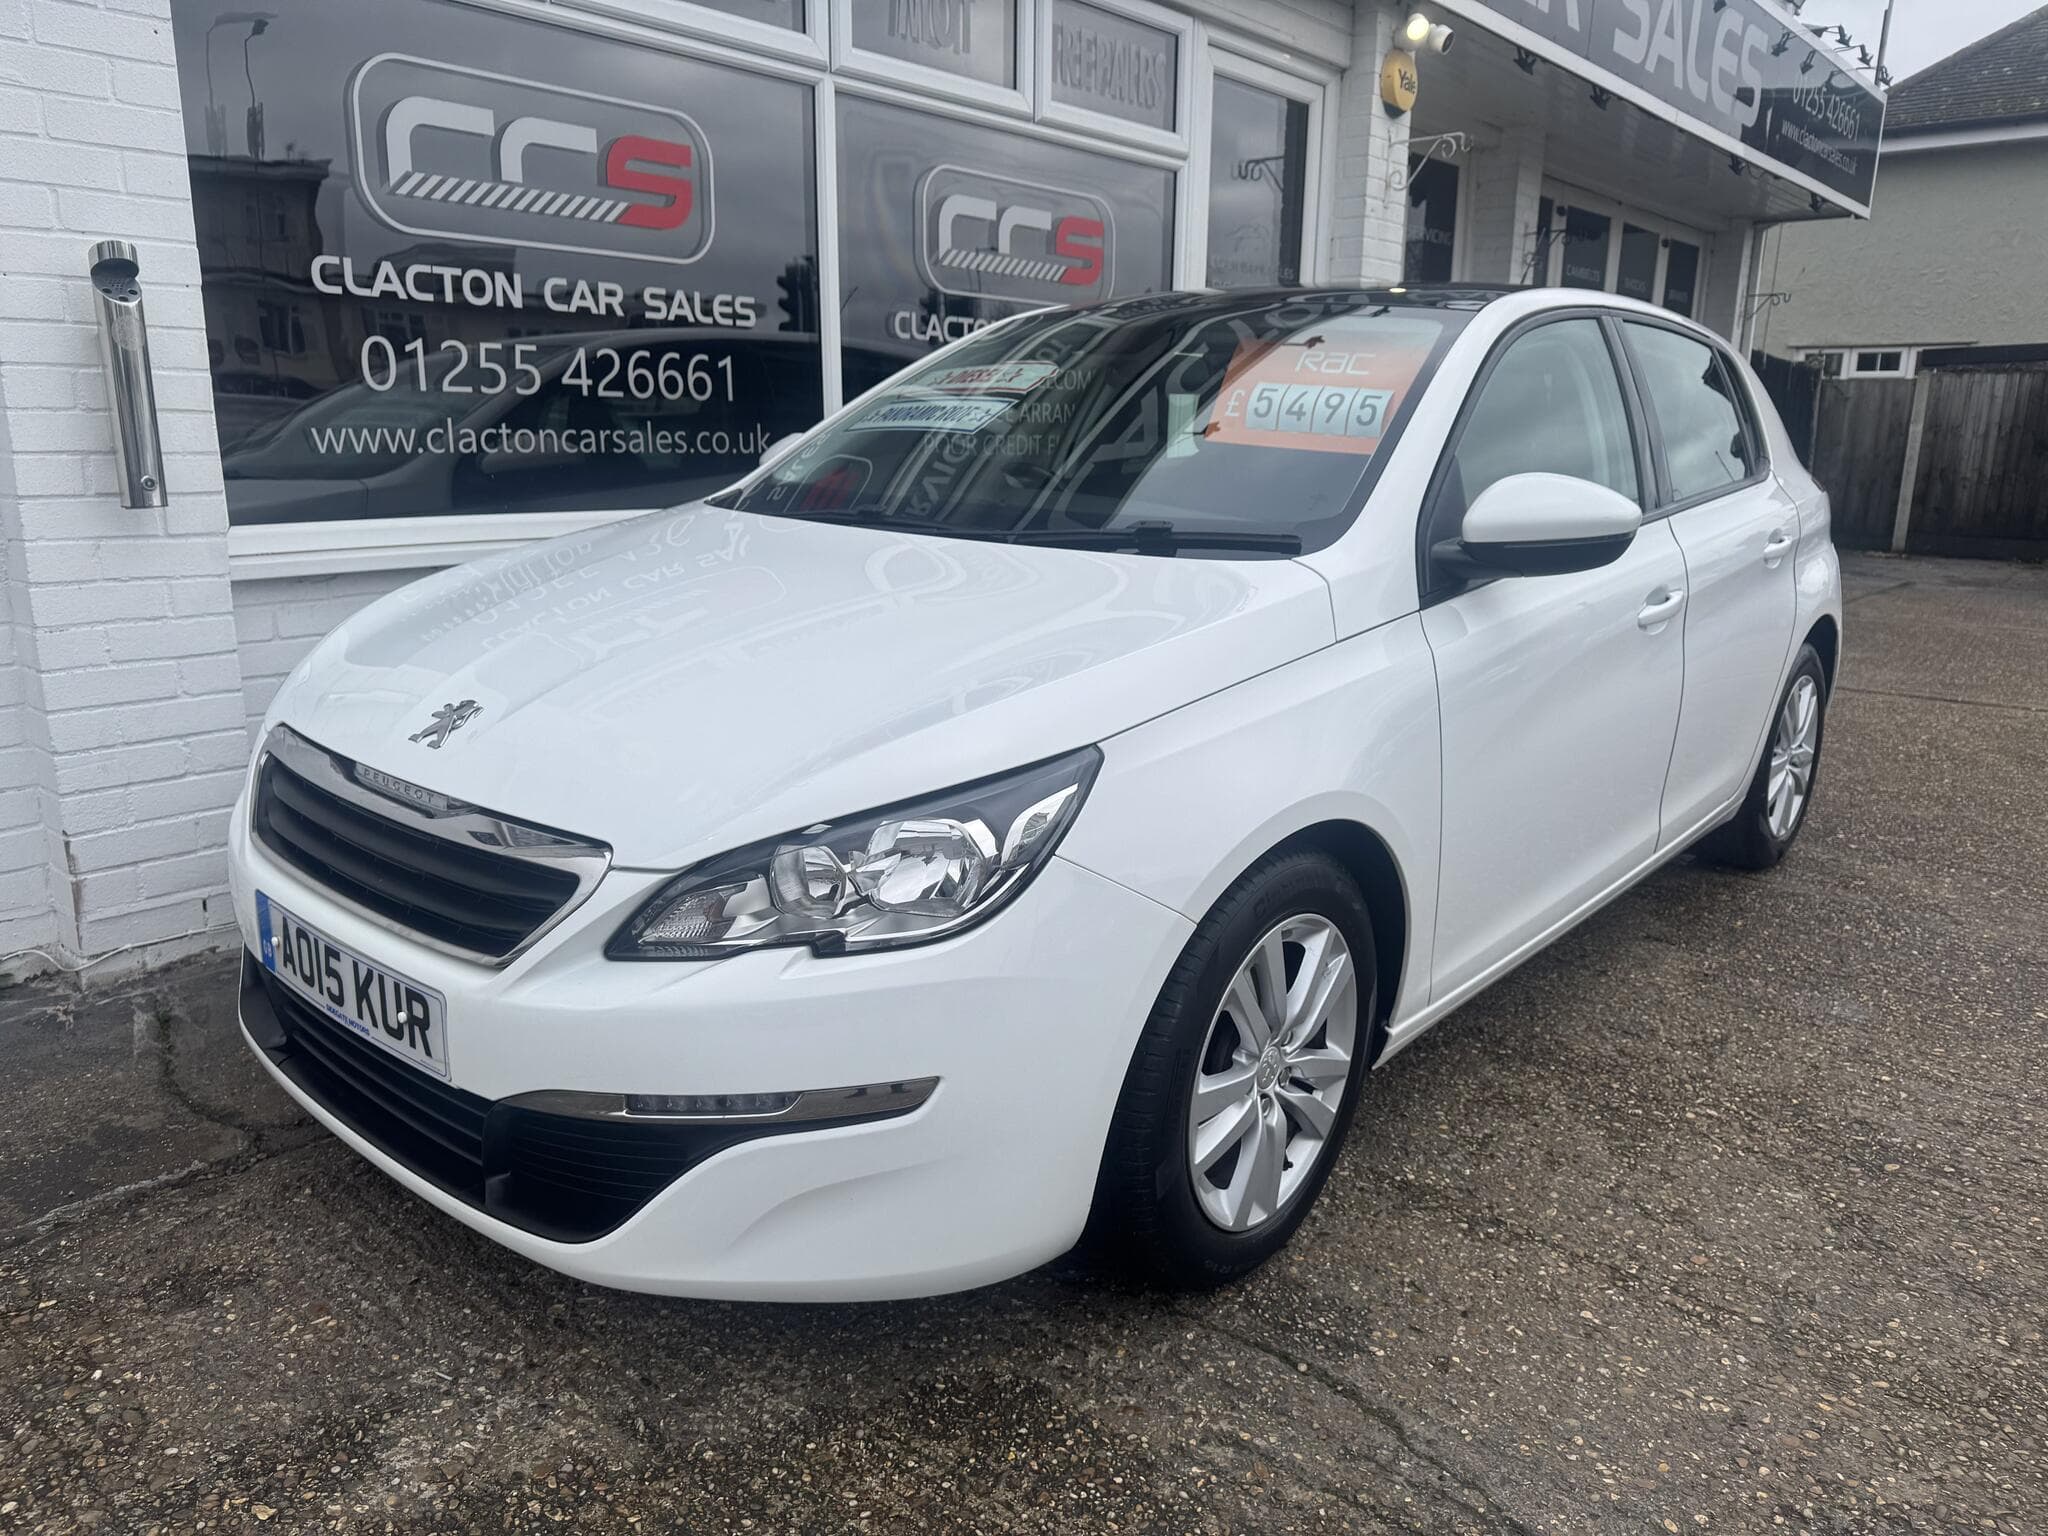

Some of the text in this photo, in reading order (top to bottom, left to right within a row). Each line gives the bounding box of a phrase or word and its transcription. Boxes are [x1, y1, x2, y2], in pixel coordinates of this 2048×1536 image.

[1398, 68, 1417, 96] Yale
[1613, 0, 1769, 127] SALES
[1793, 80, 1860, 141] 01255 426661
[386, 96, 691, 230] CCS
[939, 194, 1104, 287] CCS
[311, 256, 756, 328] CLACTON CAR SALES
[361, 335, 734, 402] 01255 426661
[311, 417, 771, 456] www.clactoncarsales.co.uk
[364, 767, 435, 803] PEUGEOT
[352, 960, 432, 1058] KUR
